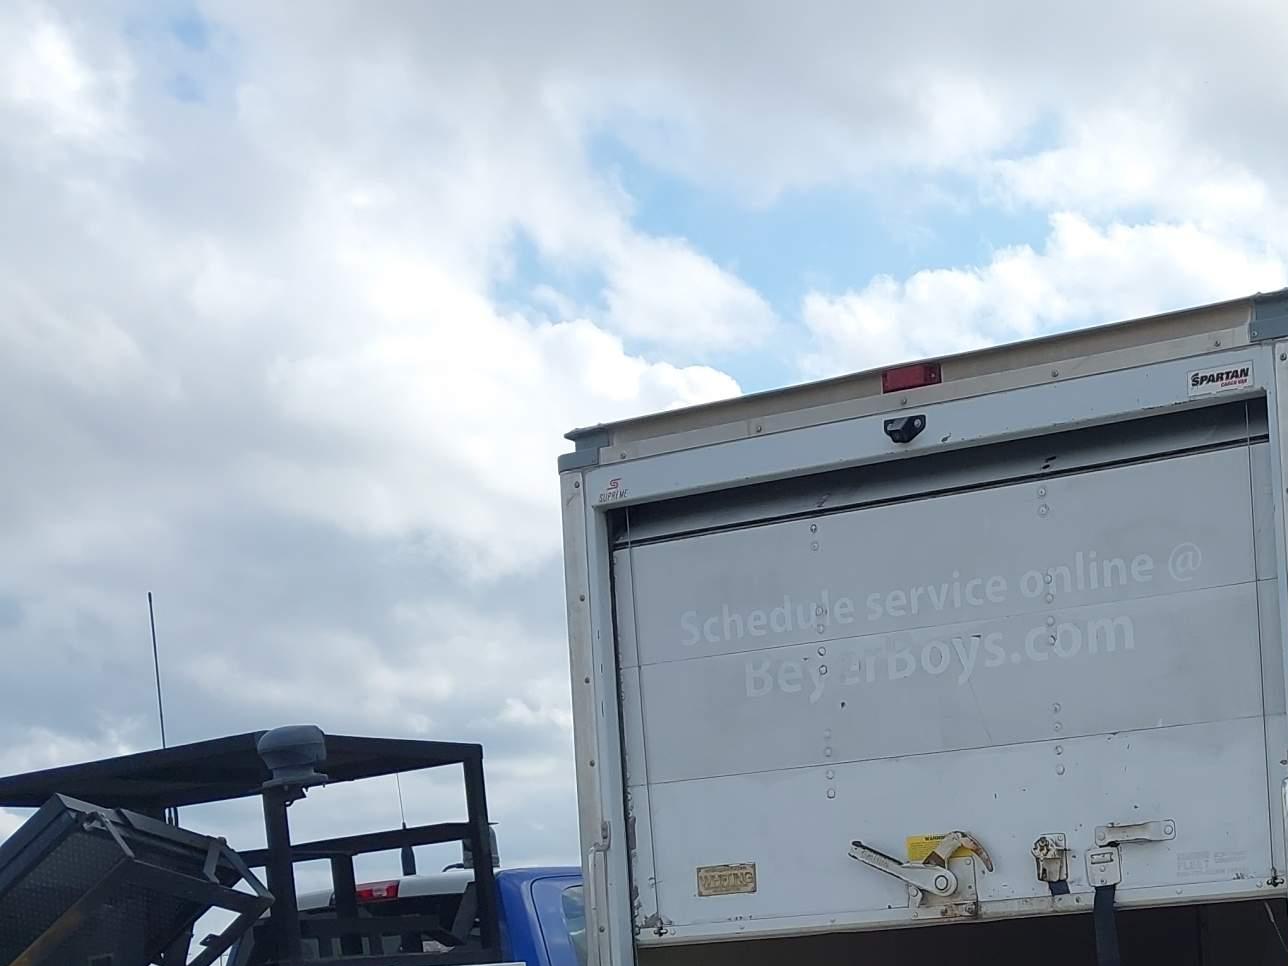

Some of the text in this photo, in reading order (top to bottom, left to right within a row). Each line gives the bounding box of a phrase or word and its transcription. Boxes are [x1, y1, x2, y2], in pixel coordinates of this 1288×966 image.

[1191, 367, 1249, 387] SPARTAN
[680, 542, 1202, 646] Schedule service online @
